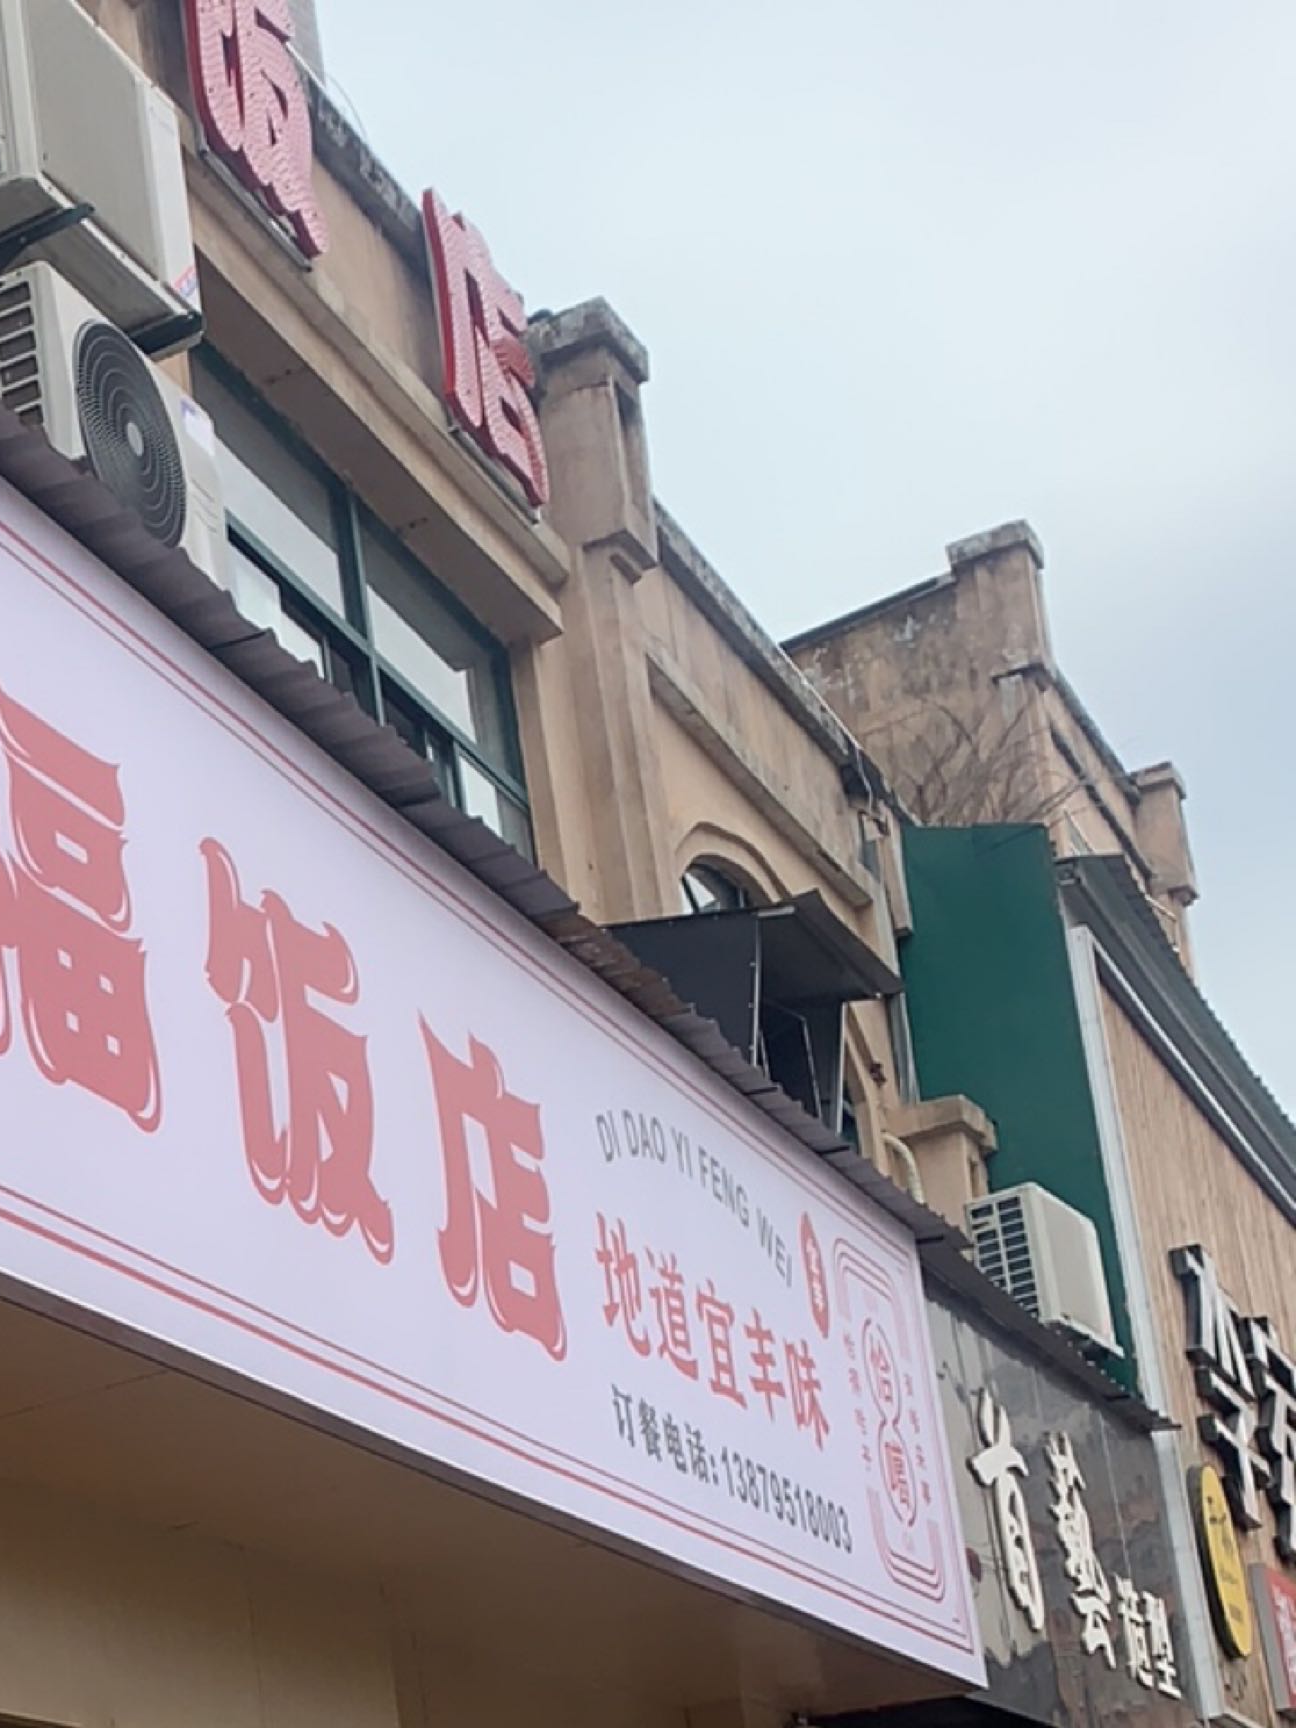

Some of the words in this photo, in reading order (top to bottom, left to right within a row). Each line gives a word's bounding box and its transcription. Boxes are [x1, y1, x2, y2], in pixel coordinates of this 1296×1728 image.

[596, 1110, 621, 1162] DI
[622, 1109, 667, 1164] DAO
[670, 1126, 693, 1179] YI
[698, 1145, 749, 1228] FENG
[756, 1208, 792, 1288] WEI
[595, 1211, 830, 1450] 地道宜丰味
